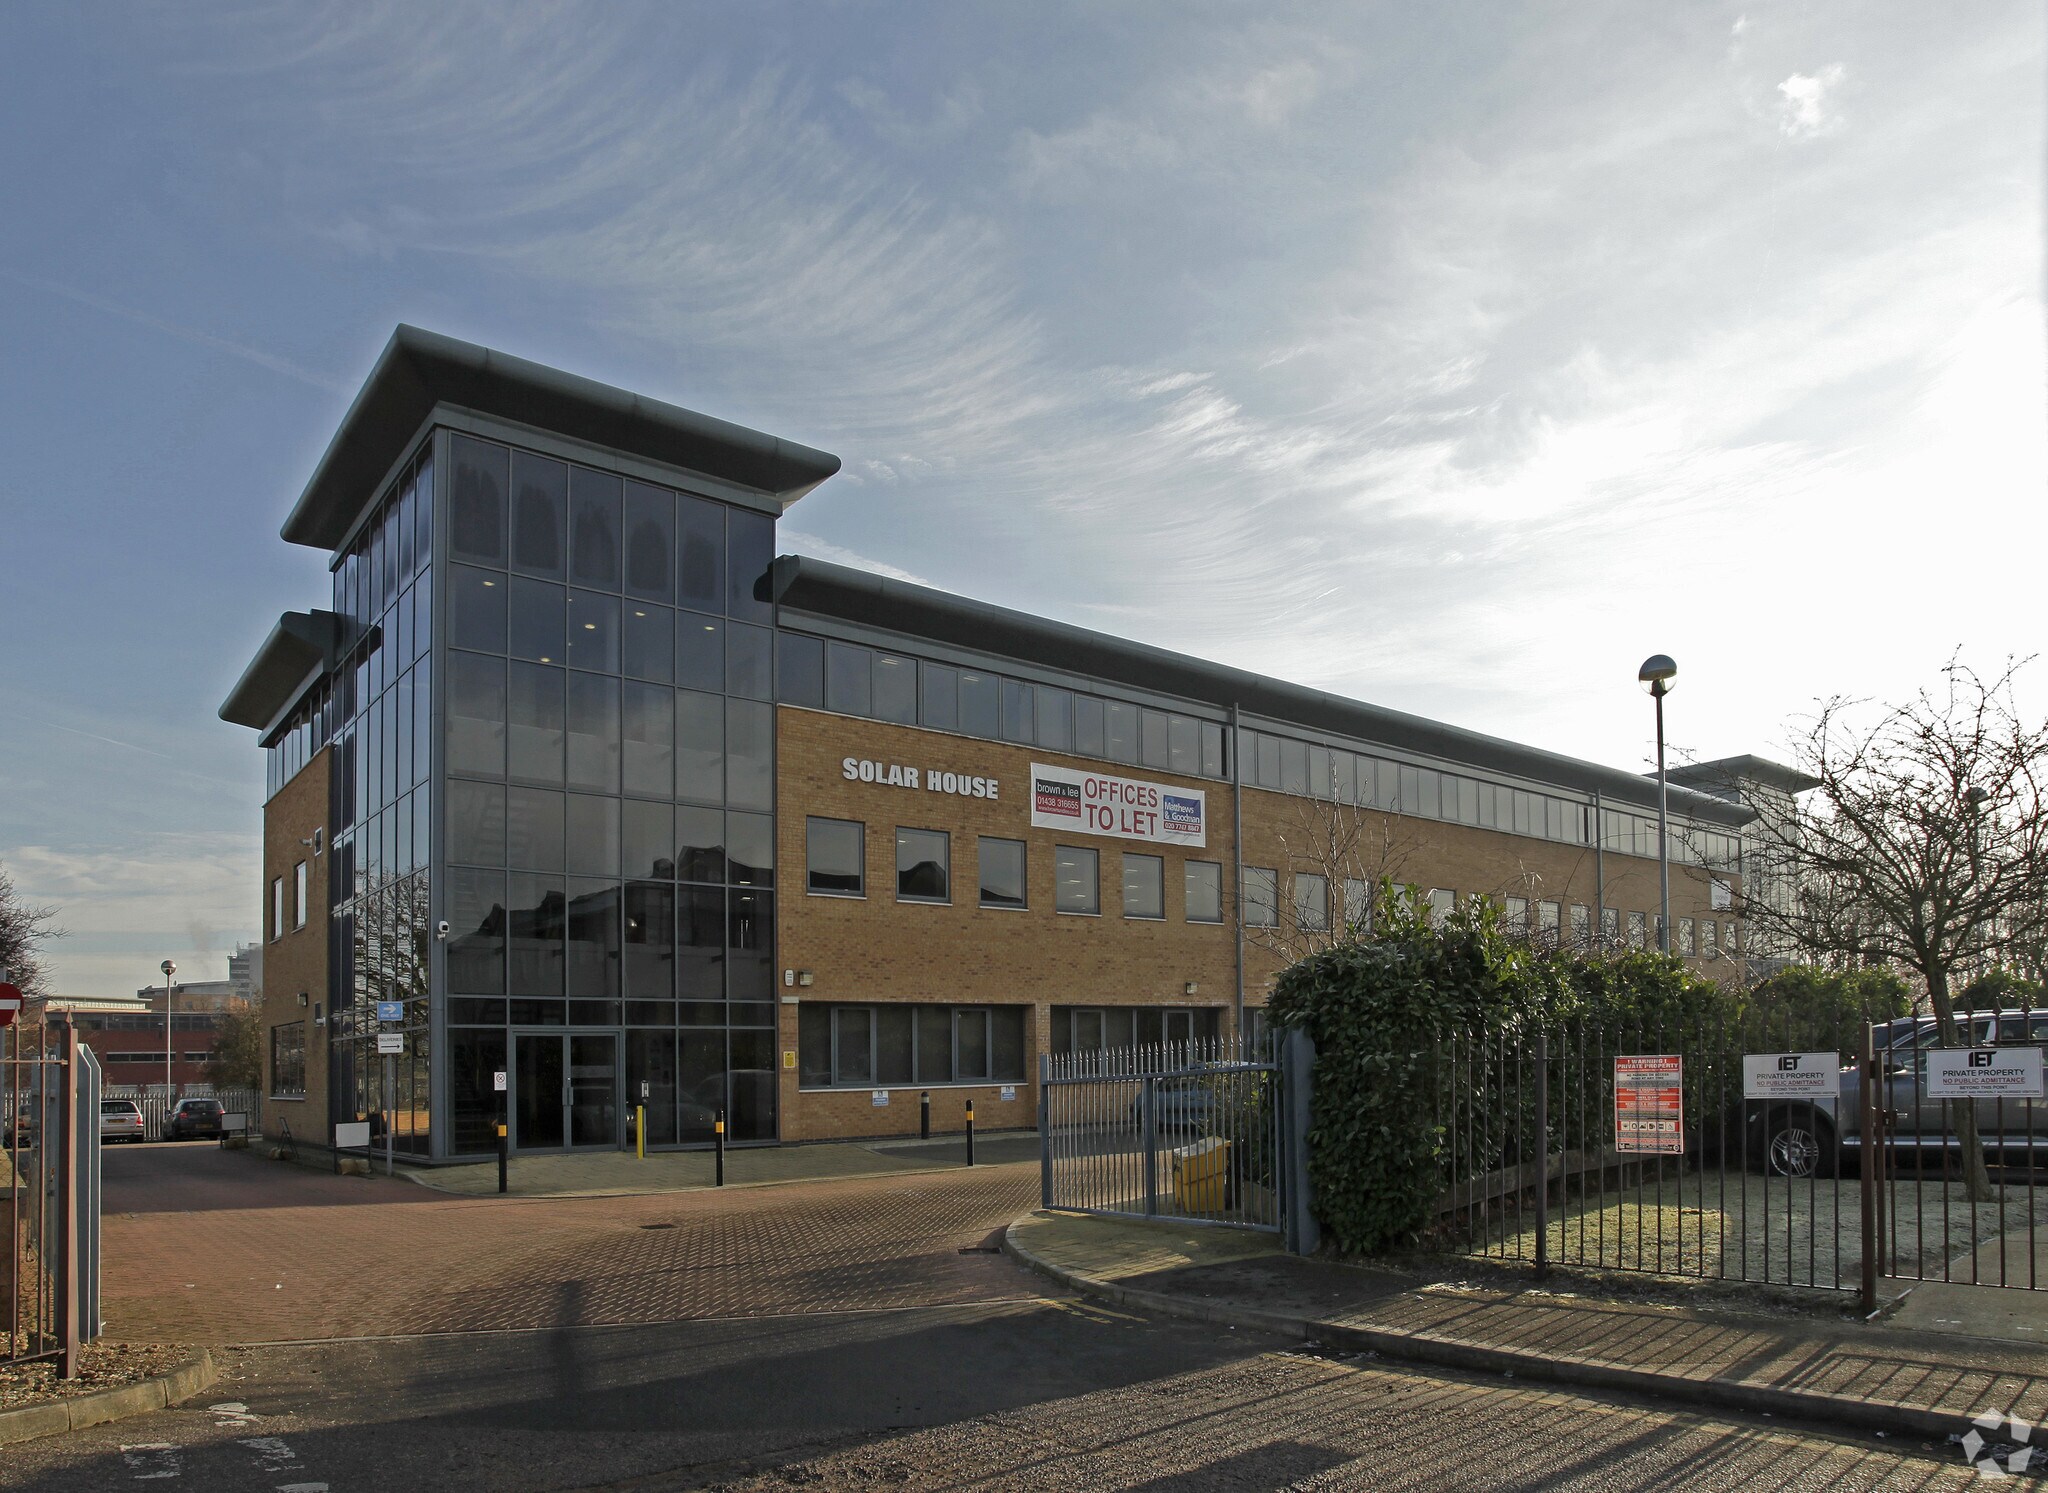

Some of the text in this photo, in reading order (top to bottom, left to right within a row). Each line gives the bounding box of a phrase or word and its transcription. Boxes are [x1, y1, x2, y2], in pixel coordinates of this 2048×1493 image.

[842, 757, 998, 799] SOLAR HOUSE
[1037, 782, 1060, 795] brown
[1067, 786, 1079, 797] lee
[1084, 778, 1158, 808] OFFICES
[1037, 796, 1056, 806] 01438
[1164, 801, 1194, 813] Matthews
[1085, 803, 1158, 836] TO LET
[1165, 811, 1200, 823] & Goodman
[1778, 1056, 1802, 1071] IET
[1968, 1051, 1997, 1067] IET
